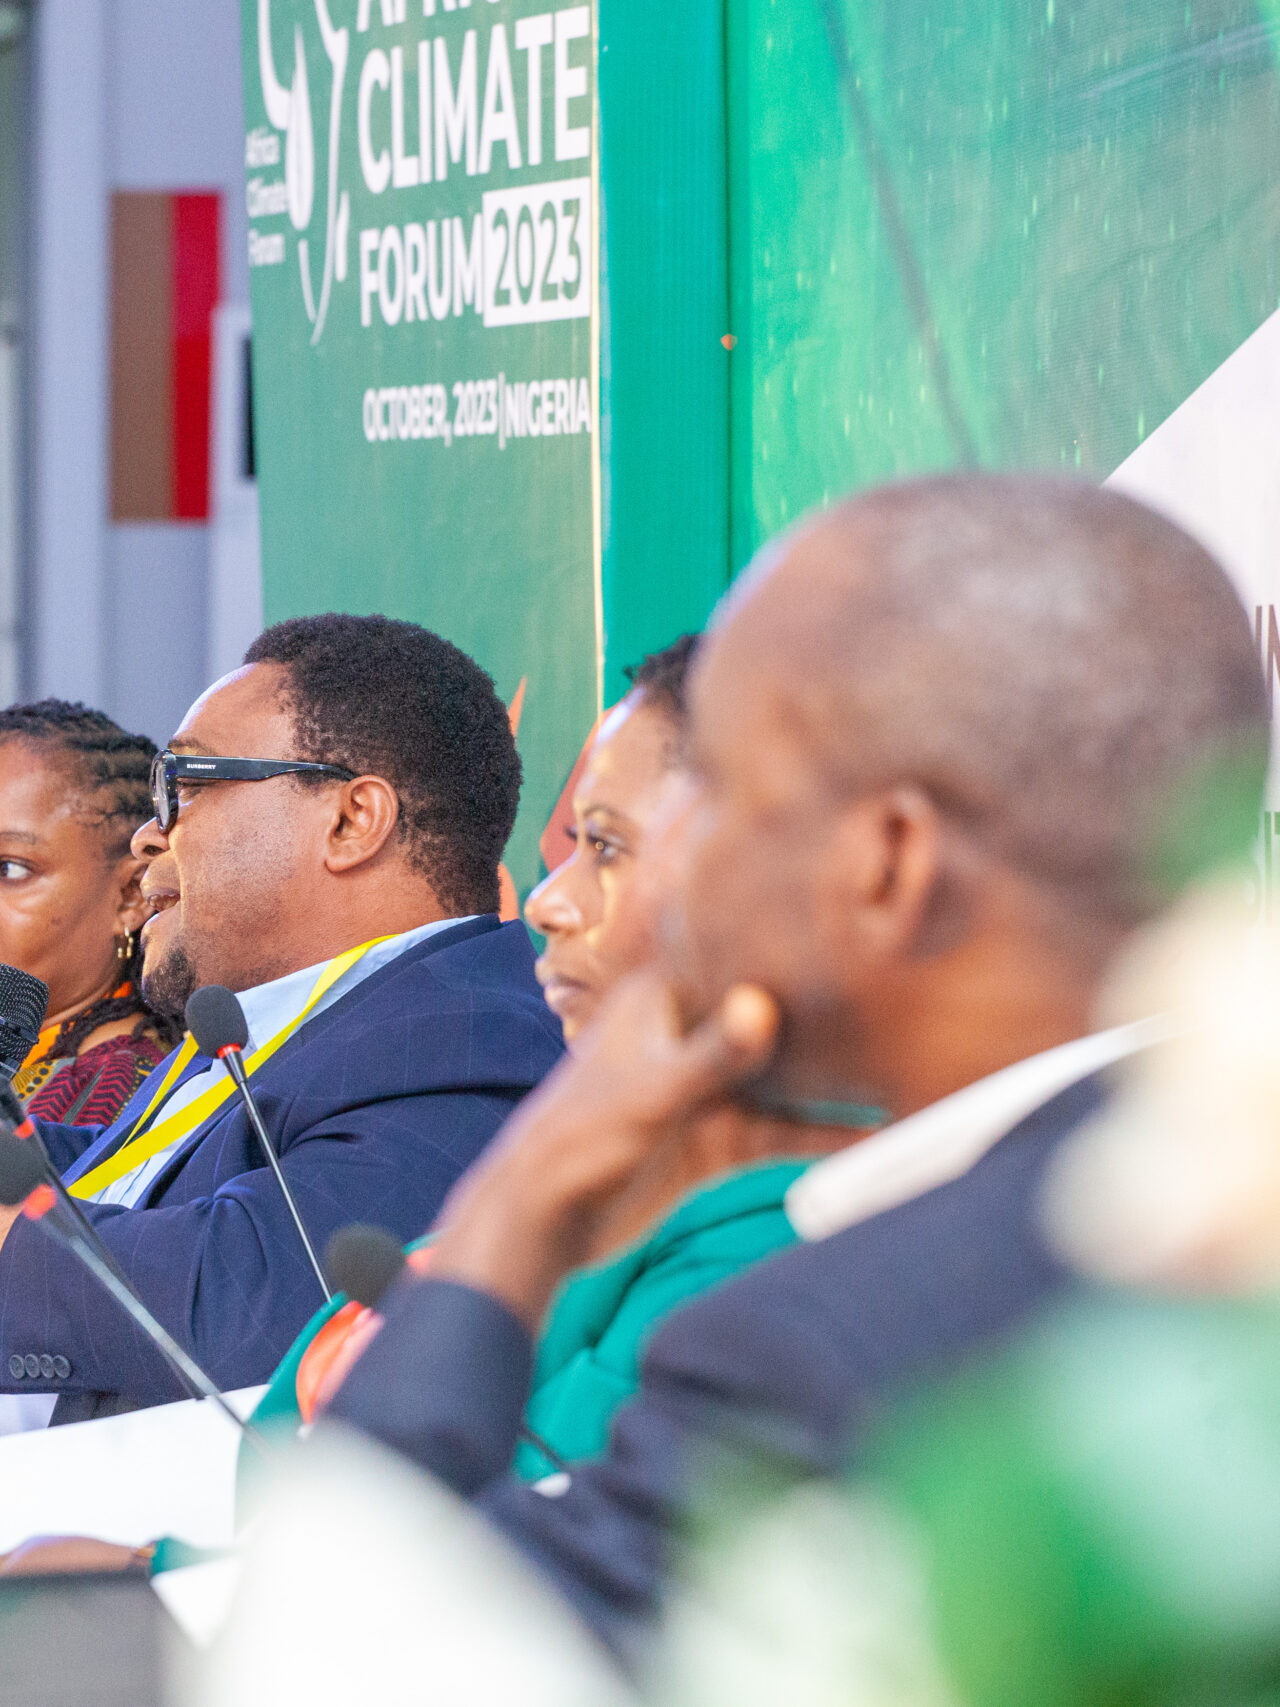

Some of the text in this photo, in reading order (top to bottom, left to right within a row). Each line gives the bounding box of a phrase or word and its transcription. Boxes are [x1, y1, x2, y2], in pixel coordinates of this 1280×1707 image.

[358, 5, 591, 195] CLIMATE
[359, 198, 582, 328] FORUM 2023
[362, 382, 453, 448] OCTOBER,
